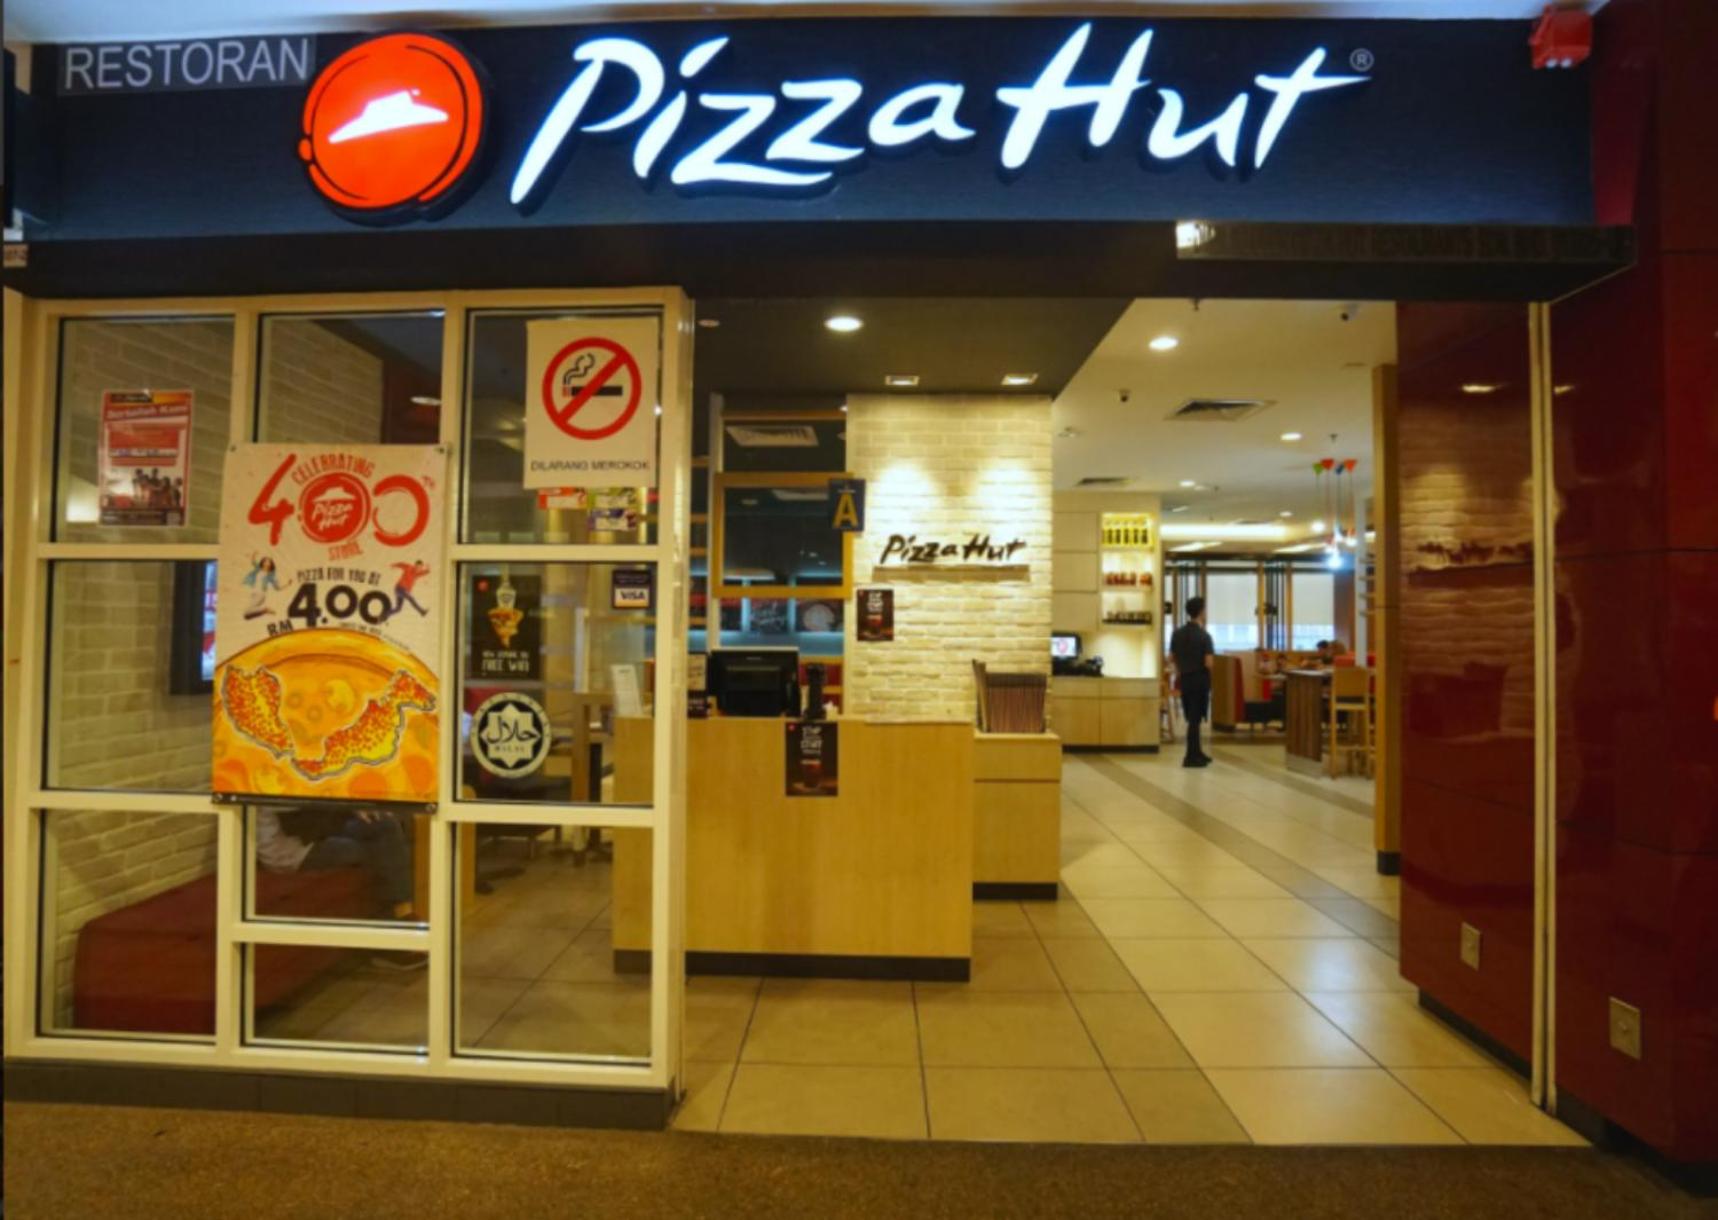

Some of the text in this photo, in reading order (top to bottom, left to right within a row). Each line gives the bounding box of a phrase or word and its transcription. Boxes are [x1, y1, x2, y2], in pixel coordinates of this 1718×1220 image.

[64, 38, 309, 90] RESTORAN
[511, 33, 976, 204] Pizza
[996, 22, 1373, 169] Hut
[292, 454, 375, 486] CELEBRATING
[530, 460, 651, 471] DILARANG MEROKOK
[311, 501, 354, 523] Pizza
[318, 513, 350, 532] Hut
[832, 491, 859, 529] A
[880, 533, 1027, 565] Pizza Hut
[297, 567, 324, 581] PIZZA
[327, 567, 345, 580] FOR
[267, 582, 393, 636] RM 4.00
[620, 590, 646, 600] VISA
[486, 715, 538, 744] حلال
